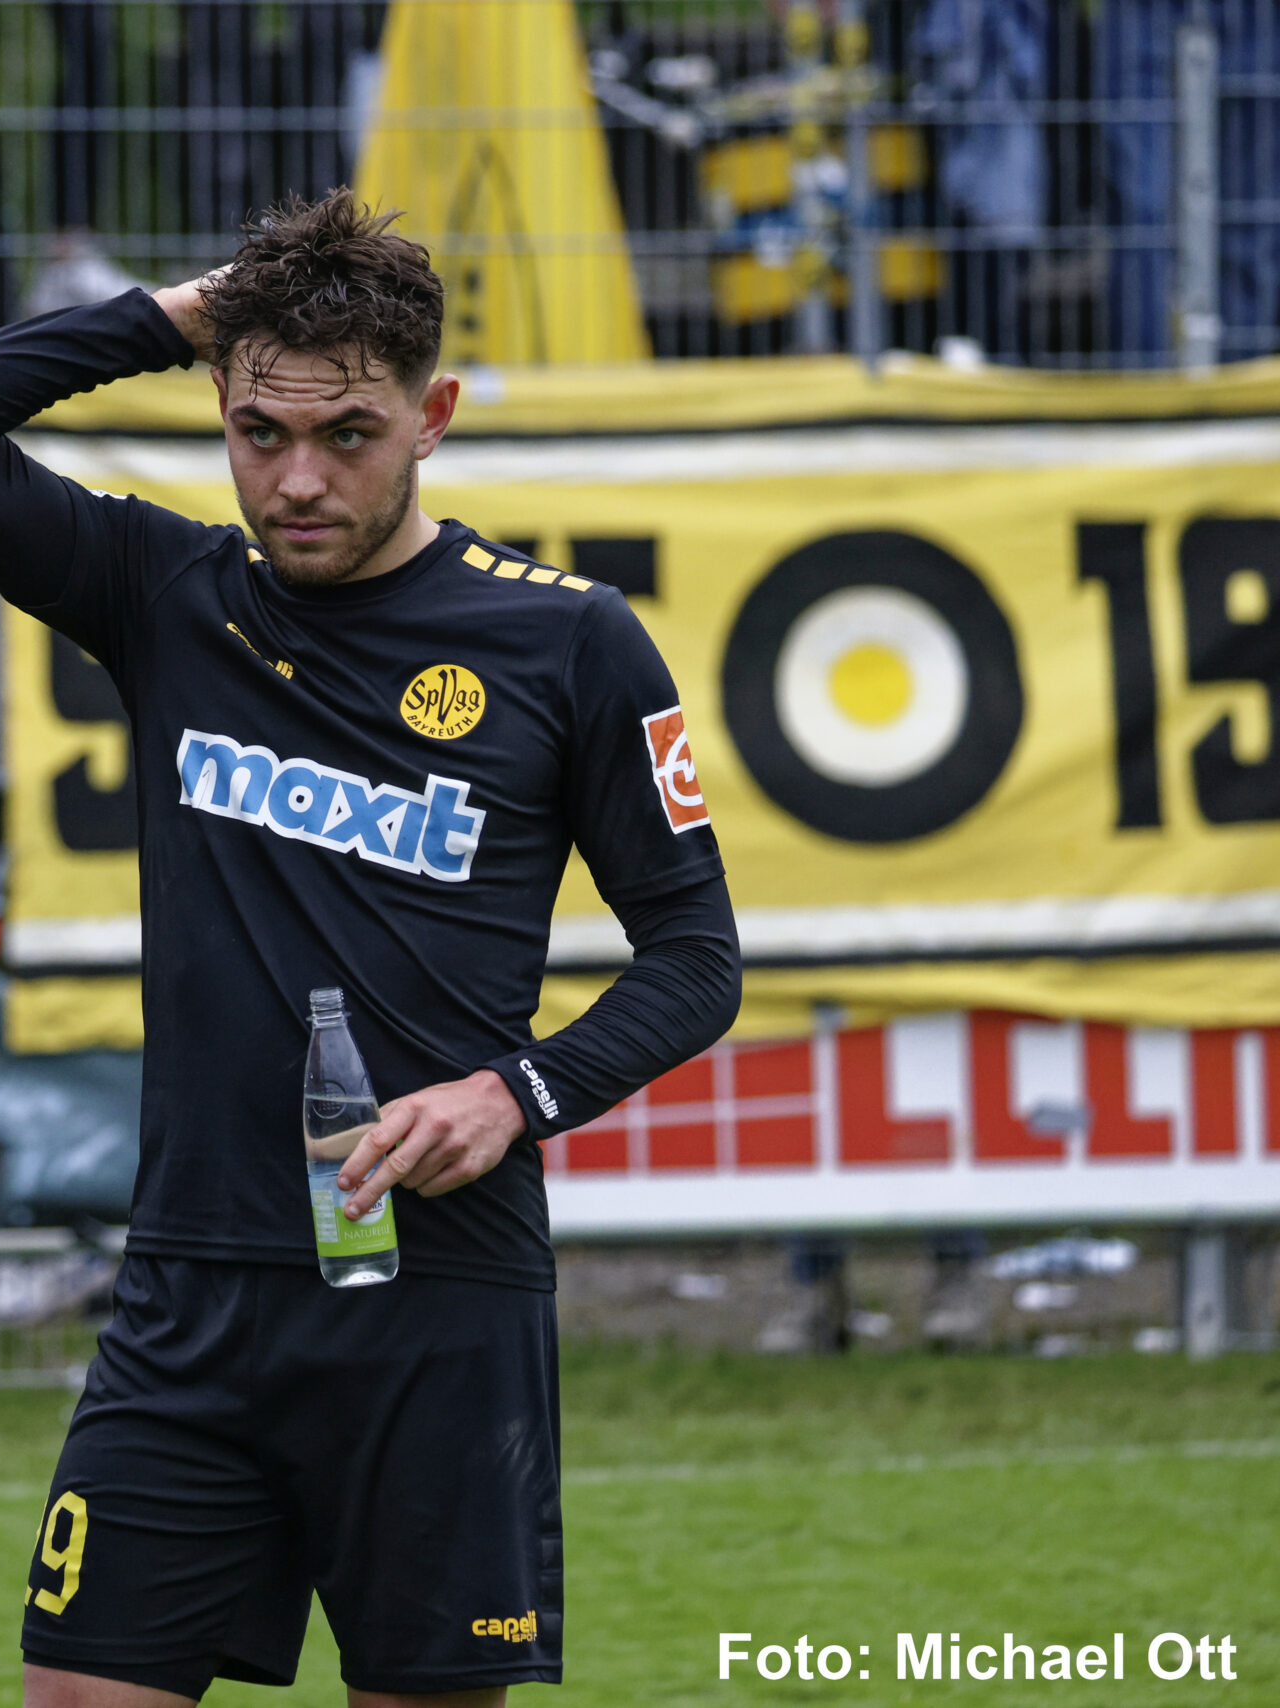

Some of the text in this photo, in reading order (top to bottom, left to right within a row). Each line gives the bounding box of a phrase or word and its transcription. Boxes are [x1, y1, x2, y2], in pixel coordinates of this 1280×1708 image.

[406, 668, 480, 726] SpVgg
[407, 715, 473, 737] BAYREUTH
[182, 740, 475, 872] maxit
[519, 1058, 559, 1120] capelli
[24, 1490, 89, 1616] 9
